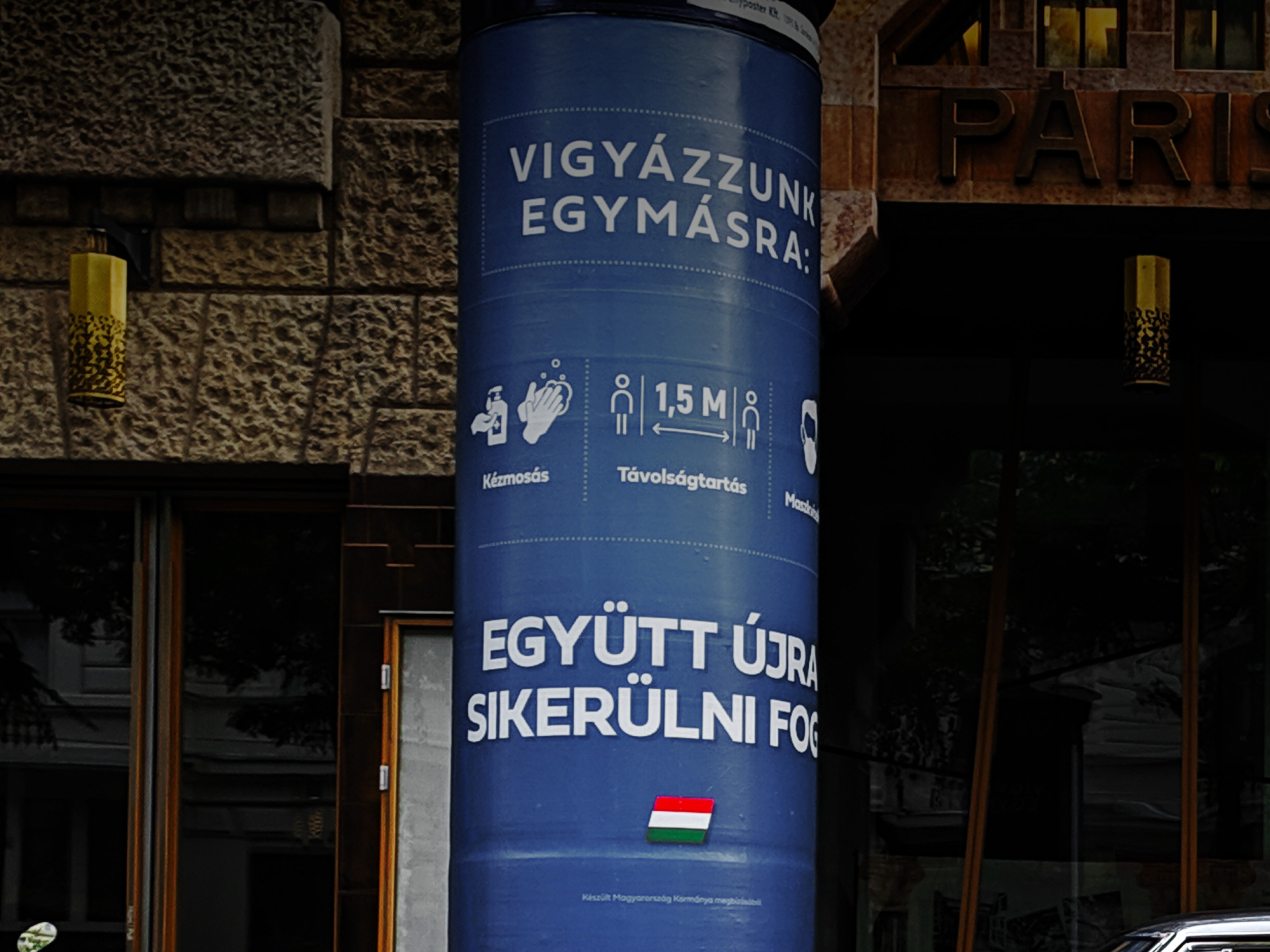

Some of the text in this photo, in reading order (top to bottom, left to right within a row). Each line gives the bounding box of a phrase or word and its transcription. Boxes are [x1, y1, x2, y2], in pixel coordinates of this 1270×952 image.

[509, 133, 816, 227] VIGYÁZZUNK
[522, 194, 811, 274] EGYMÁSRA:
[655, 382, 727, 420] 1,5 M
[482, 468, 550, 490] Kézmosás
[617, 466, 748, 495] Távolságtartás
[482, 600, 818, 692] EGYÜTT ÚJRA
[467, 672, 756, 744] SIKERÜLNI
